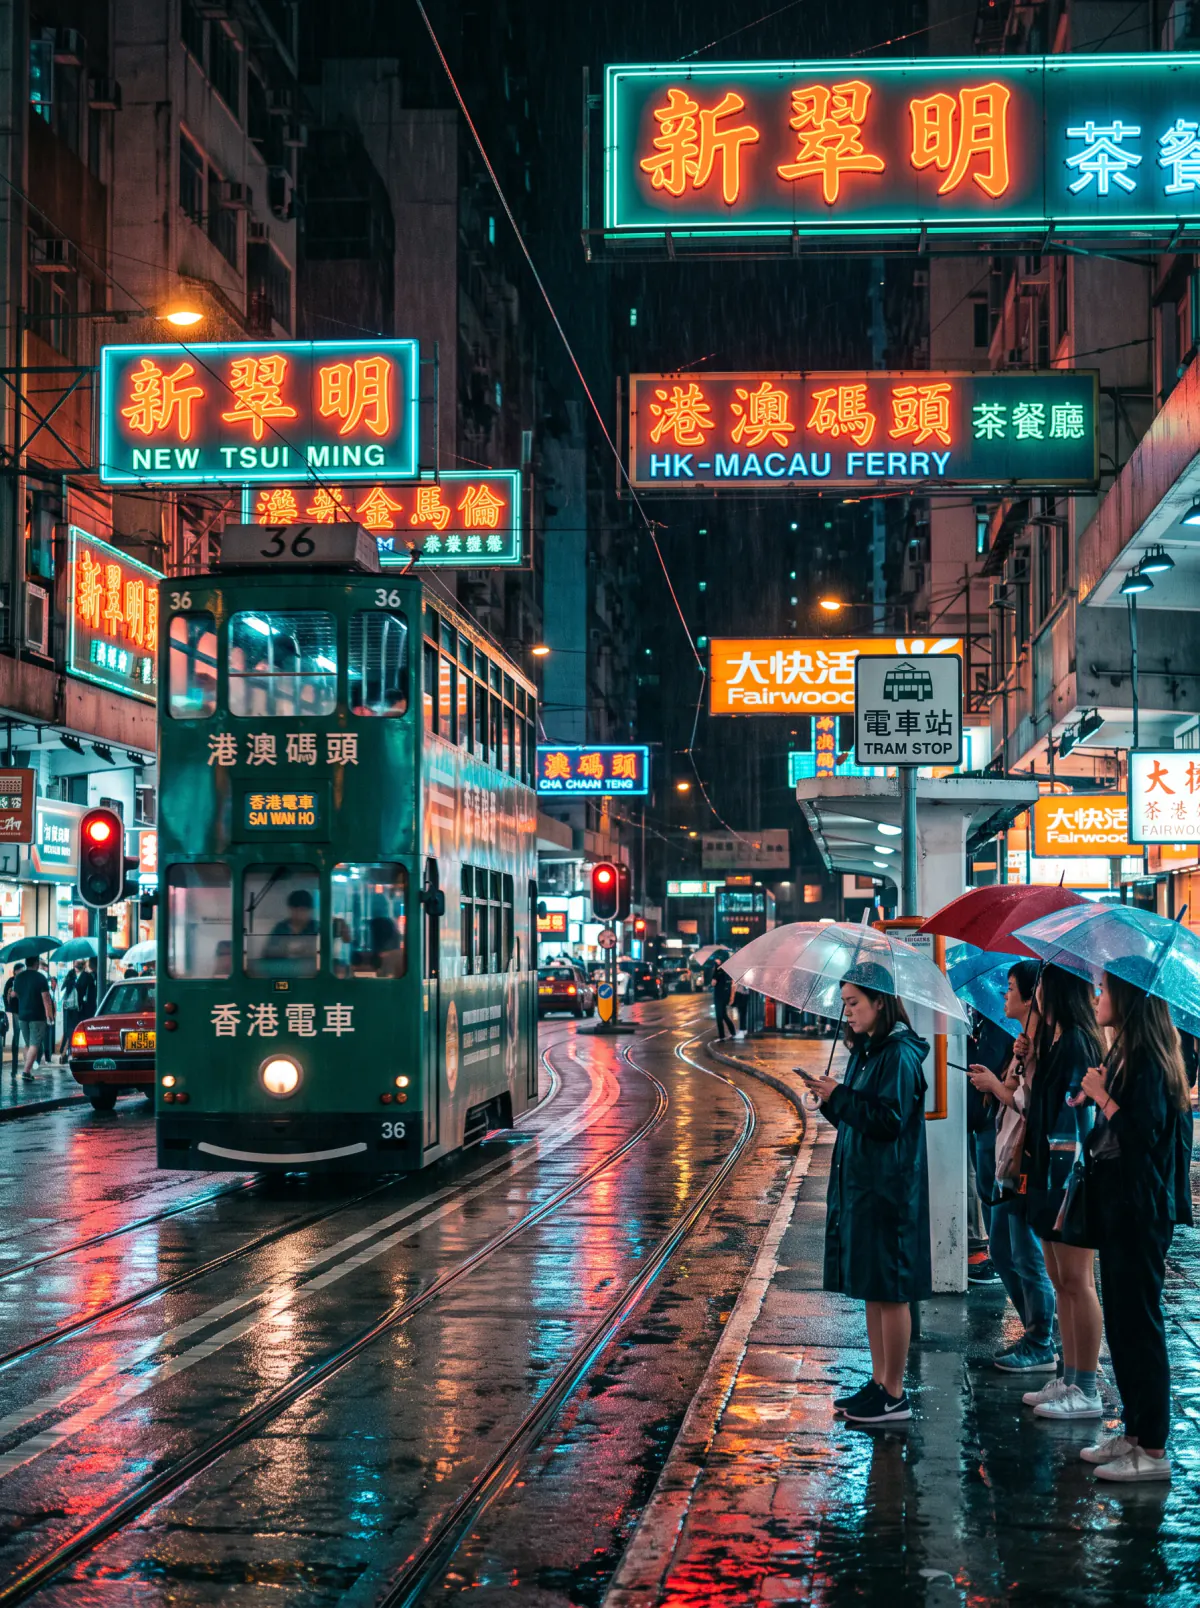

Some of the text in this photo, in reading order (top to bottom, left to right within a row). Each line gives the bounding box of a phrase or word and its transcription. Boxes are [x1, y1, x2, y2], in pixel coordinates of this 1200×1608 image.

[639, 79, 1011, 205] 新翠明
[121, 354, 392, 442] 新翠明
[649, 381, 953, 447] 港澳碼頭
[971, 400, 1085, 440] 茶餐廳
[132, 444, 386, 470] NEW TSUI MING
[650, 450, 952, 478] HK-MACAU FERRY
[260, 526, 316, 558] 36
[170, 591, 192, 610] 36
[374, 588, 402, 608] 36
[726, 649, 858, 685] 大快活
[863, 708, 953, 737] 電車站
[207, 732, 359, 766] 港澳碼頭
[864, 742, 953, 755] TRAM STOP
[540, 779, 634, 789] CHA CHAAN TENG
[249, 794, 314, 810] 香港電車
[1144, 800, 1200, 821] 茶港
[249, 811, 315, 825] SAI WAN HO
[1046, 807, 1127, 830] 大快活
[210, 1002, 356, 1037] 香港電車
[381, 1121, 406, 1140] 36
